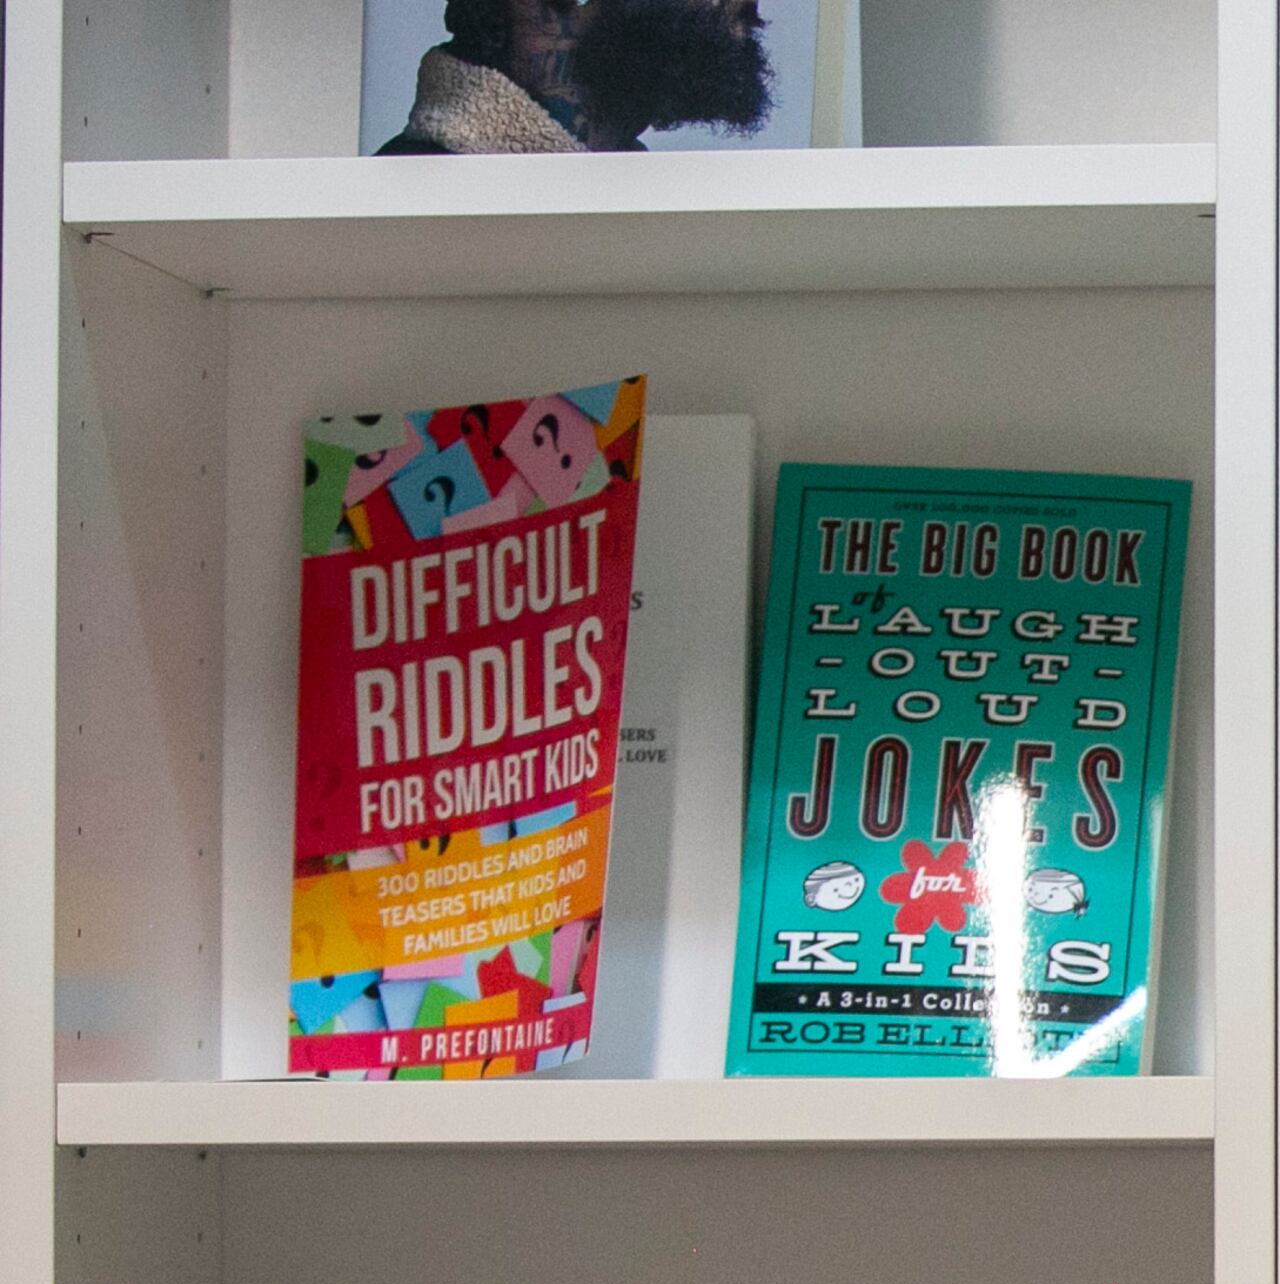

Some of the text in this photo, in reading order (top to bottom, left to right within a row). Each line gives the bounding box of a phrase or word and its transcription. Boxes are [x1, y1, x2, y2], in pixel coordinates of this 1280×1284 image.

[350, 510, 607, 651] DIFFICULT
[818, 519, 1145, 586] THE BIG BOOK
[810, 604, 1139, 644] LAUGH
[852, 584, 896, 613] of
[354, 616, 603, 769] RIDDLES
[804, 688, 1128, 730] LOUD
[360, 729, 600, 834] FOR SMART KIDS
[786, 734, 1124, 849] JOKES
[378, 828, 588, 899] 300 RIDDLES AND BRAIN
[909, 866, 967, 900] for
[379, 859, 586, 928] TEASERS THAT KIDS AND
[404, 896, 570, 955] FAMILIES WILL LOVE
[816, 993, 911, 1010] A 3-in-1
[381, 1019, 554, 1064] M. PREFONTAINE
[759, 1022, 865, 1044] ROB
